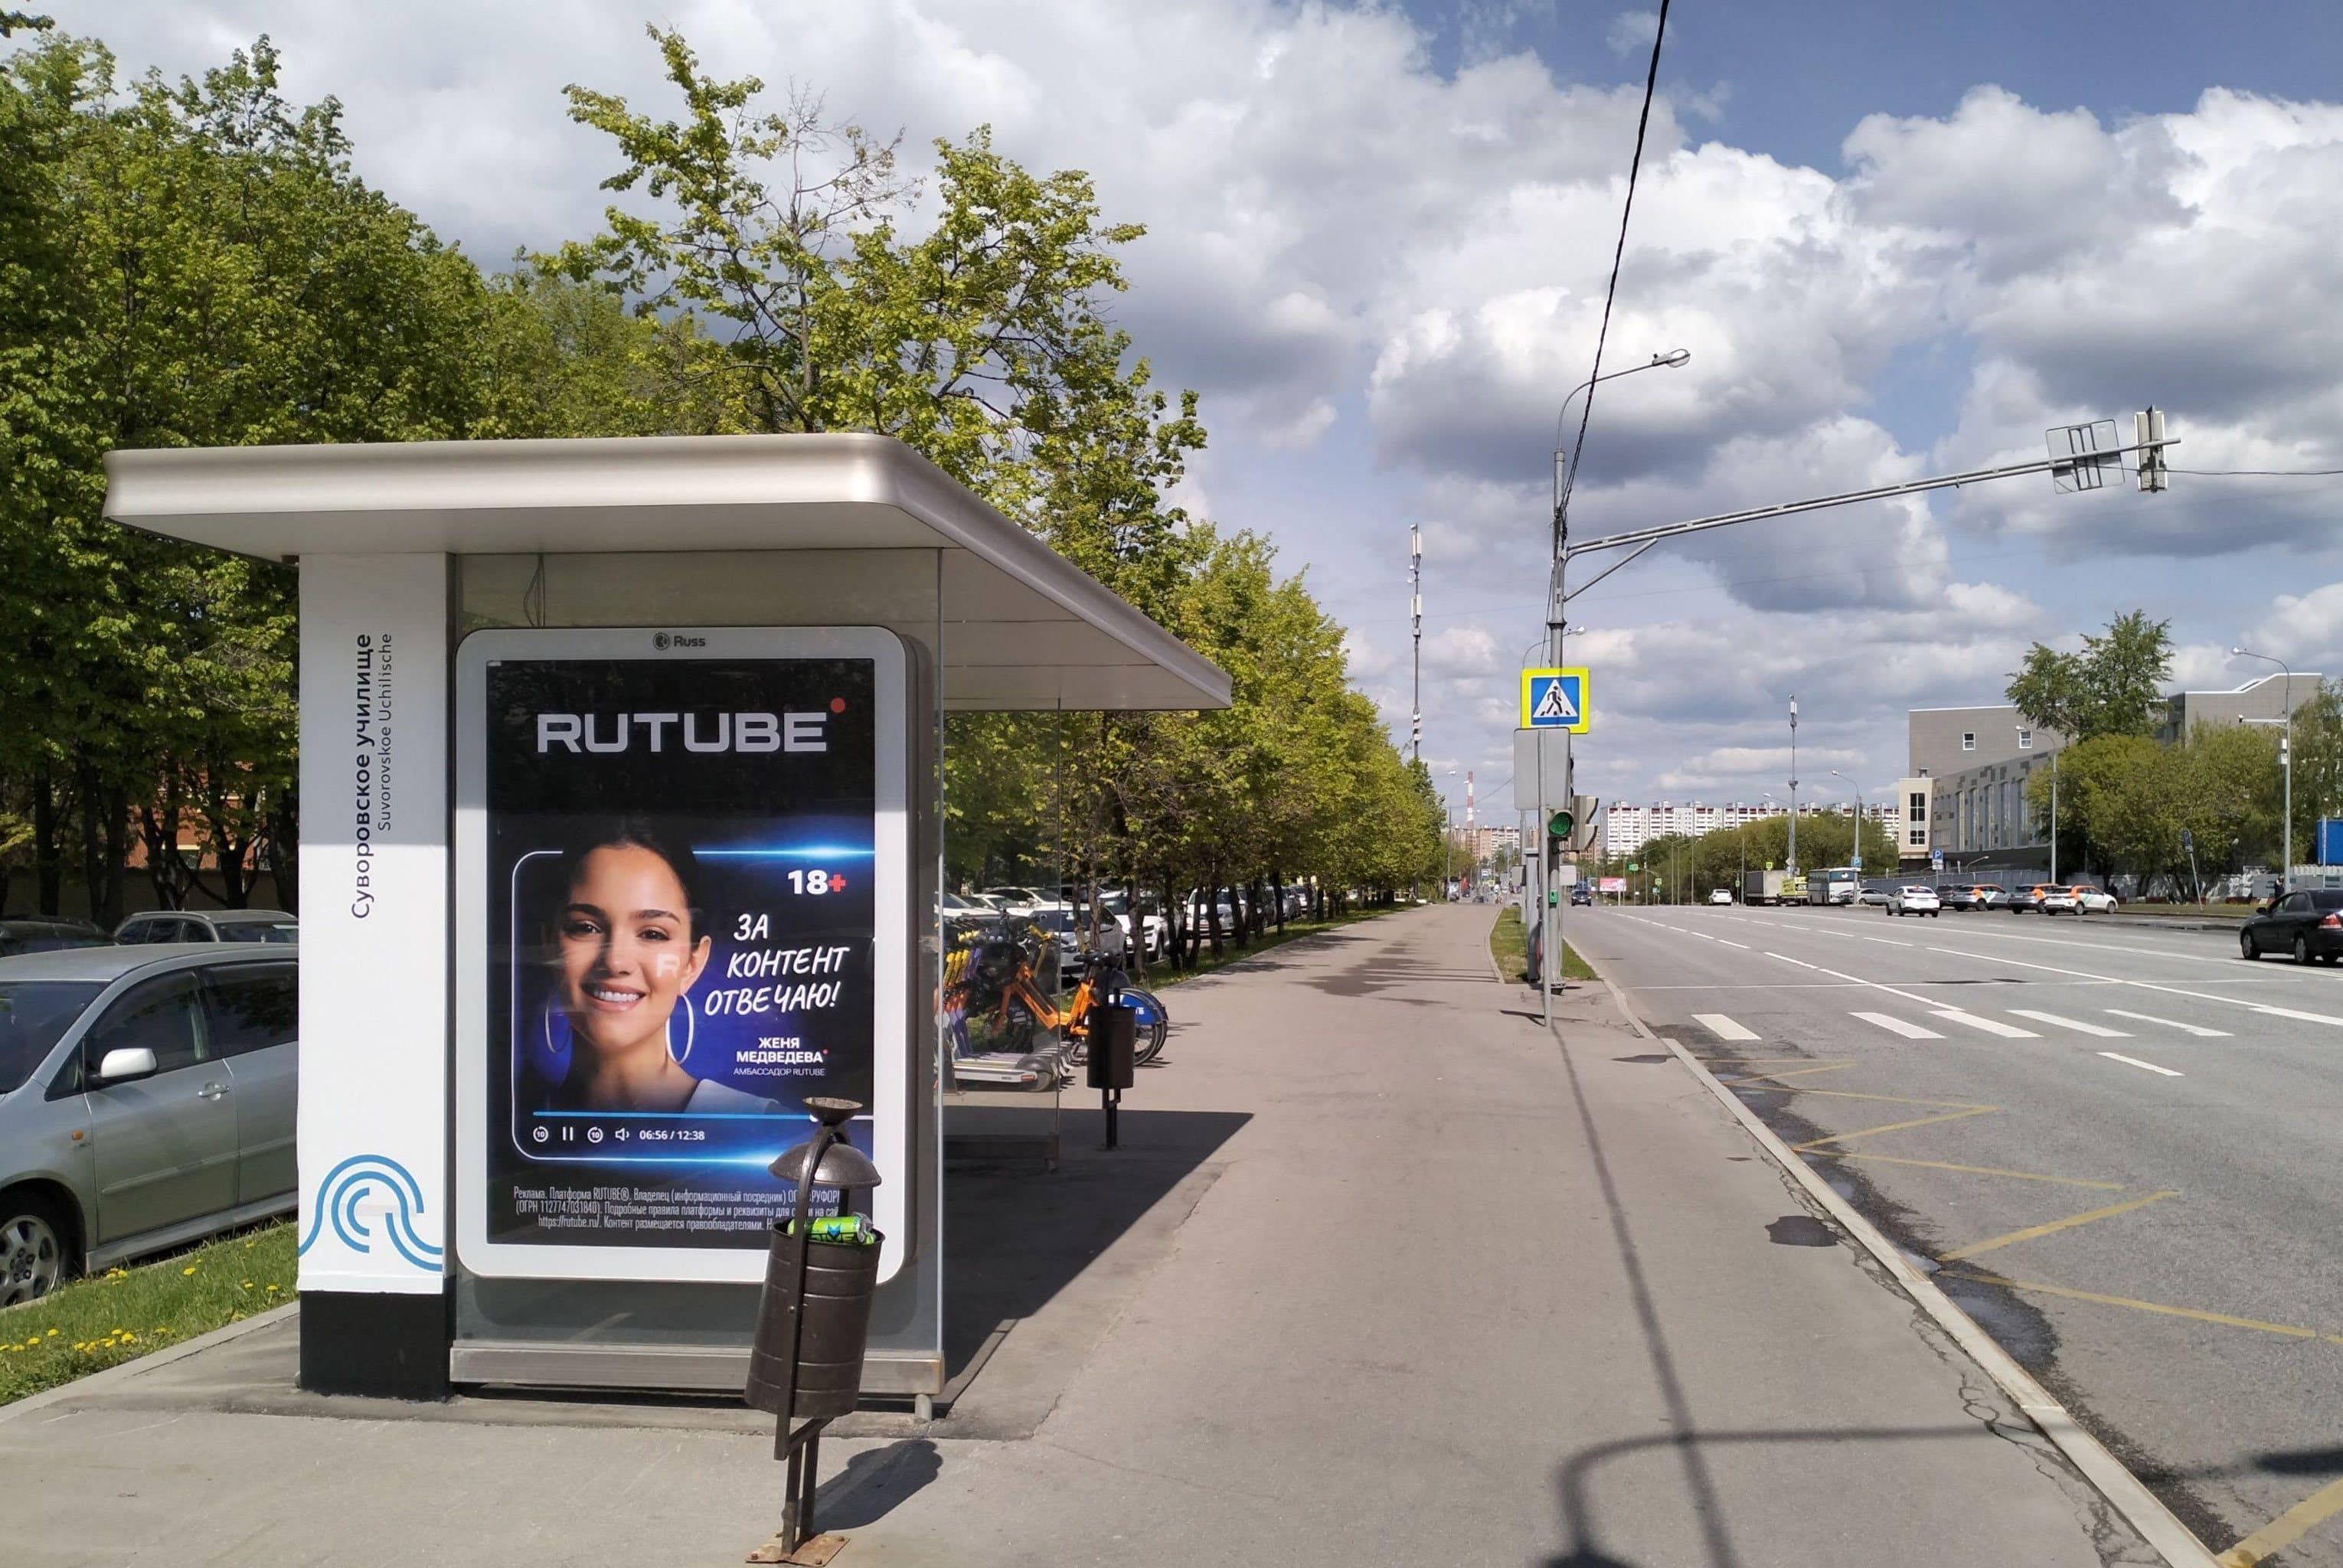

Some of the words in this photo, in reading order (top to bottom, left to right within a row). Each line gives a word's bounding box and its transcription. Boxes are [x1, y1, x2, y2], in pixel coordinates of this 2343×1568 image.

[673, 635, 706, 647] Russ
[356, 633, 375, 746] училище
[377, 633, 392, 721] Uchilische
[538, 712, 827, 753] RUTUBE
[377, 727, 392, 831] Suvorovskoe
[351, 753, 374, 919] Суворовское
[787, 870, 847, 896] 18+
[733, 913, 769, 941] ЗА
[727, 946, 851, 978] КОНТЕНТ
[704, 981, 841, 1017] ОТВЕЧАЮ!
[758, 1037, 800, 1049] ЖЕНЯ
[736, 1050, 823, 1064] МЕДВЕДЕВА
[733, 1067, 792, 1076] АМБАССАДОР
[792, 1067, 825, 1076] RUTUBE
[639, 1130, 668, 1140] 06:56
[677, 1130, 705, 1141] 12:38
[514, 1186, 547, 1199] Реклама.
[549, 1187, 591, 1201] Платформа
[634, 1188, 669, 1202] Владелец
[671, 1189, 741, 1204] (информационный
[743, 1190, 786, 1205] посредник)
[605, 1201, 647, 1216] Подробные
[649, 1205, 679, 1218] правила
[681, 1203, 725, 1218] платформы
[734, 1207, 774, 1218] реквизиты
[604, 1215, 633, 1229] Контент
[636, 1218, 684, 1231] размещается
